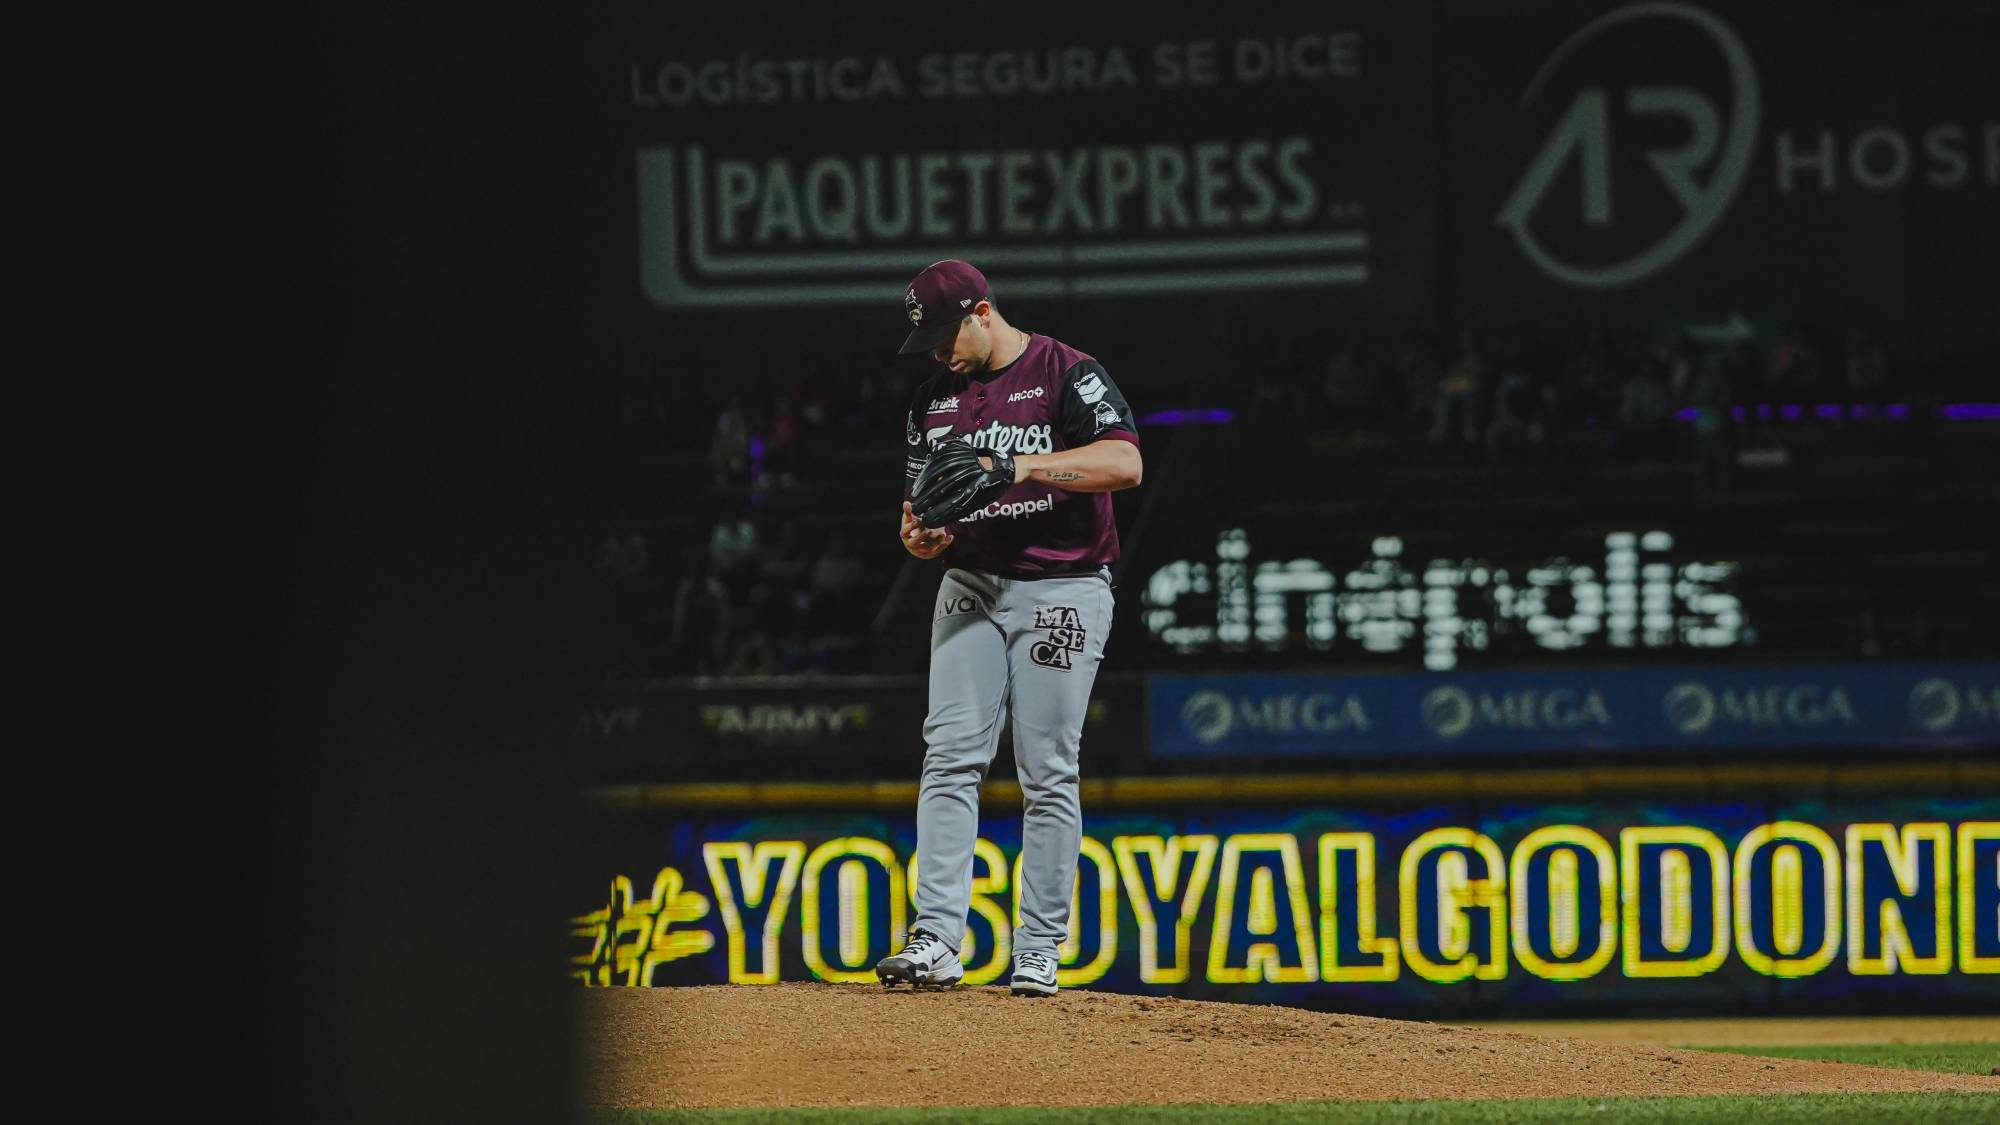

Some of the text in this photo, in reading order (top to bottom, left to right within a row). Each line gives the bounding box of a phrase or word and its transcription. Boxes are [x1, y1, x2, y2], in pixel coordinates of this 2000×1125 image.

[630, 33, 1361, 106] LOGÍSTICA SEGURA SE DICE
[717, 137, 1319, 243] PAQUETEXPRESS
[1007, 390, 1034, 403] ARCO
